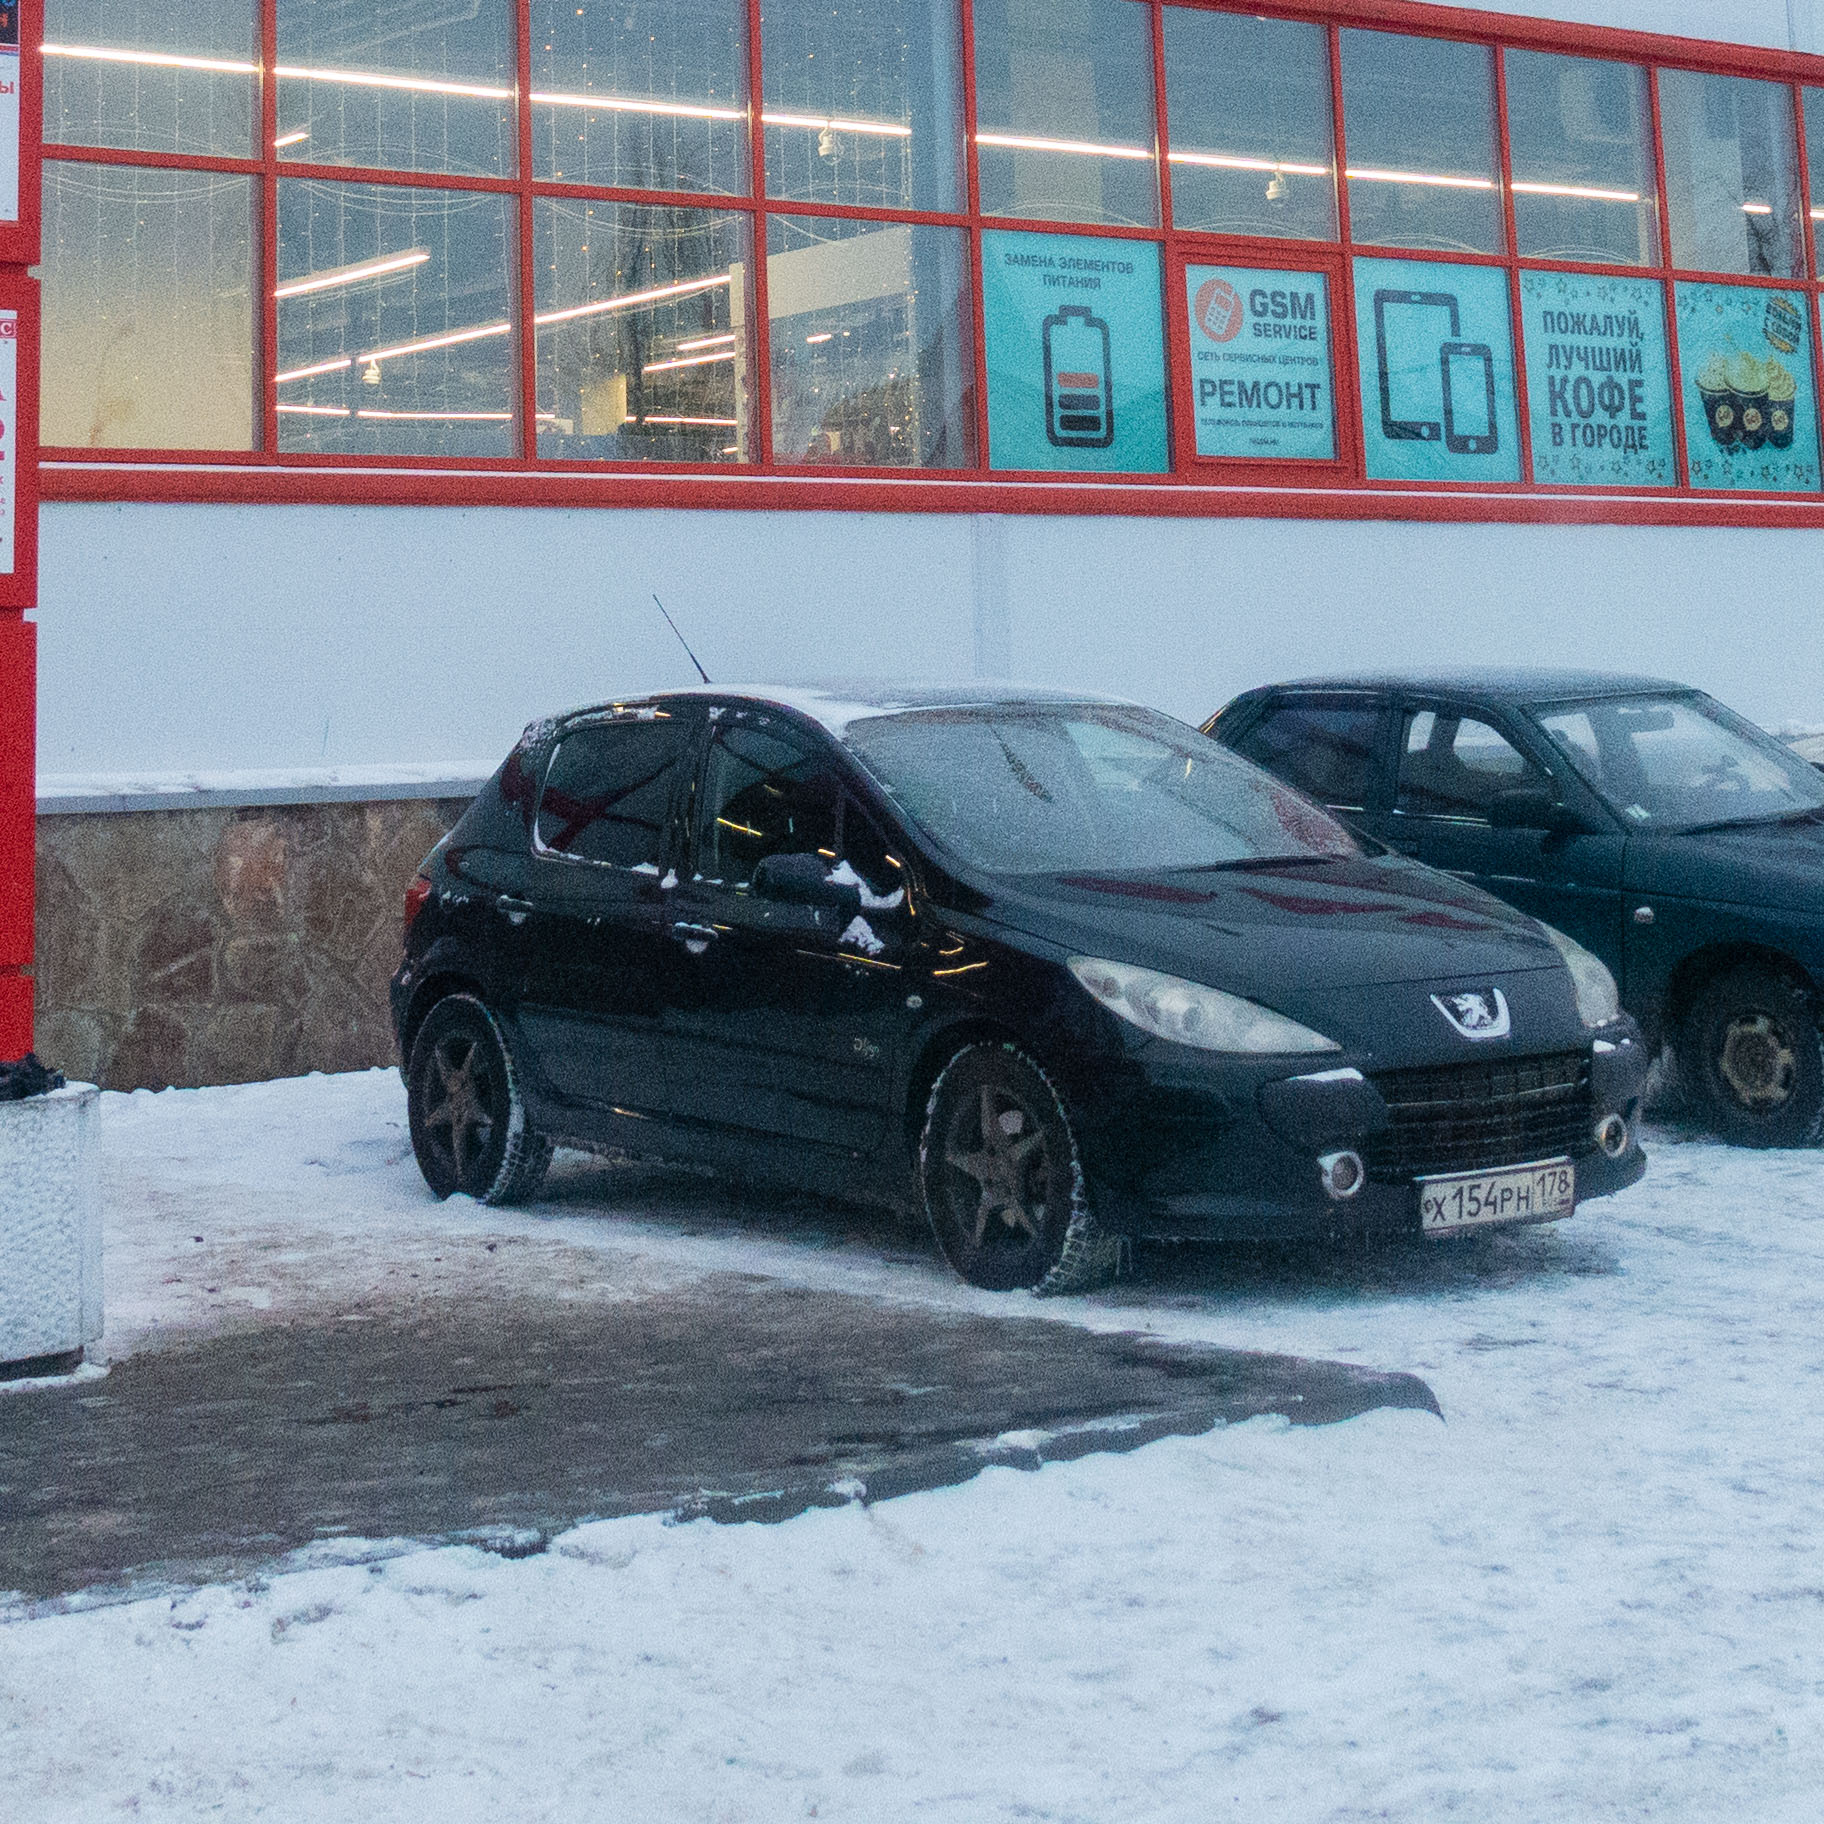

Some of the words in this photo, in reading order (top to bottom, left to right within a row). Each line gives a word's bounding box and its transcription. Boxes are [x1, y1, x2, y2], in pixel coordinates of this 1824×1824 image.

[1004, 253, 1055, 268] ЗАМЕНА
[1059, 257, 1134, 274] ЭЛЕМЕНТОВ
[1042, 274, 1101, 289] ПИТАНИЯ
[1249, 288, 1316, 321] GSM
[1252, 322, 1318, 341] SERVICE
[1542, 309, 1644, 341] ПОЖАЛУЙ,
[1547, 341, 1643, 373] ЛУЧШИЙ
[1199, 378, 1321, 411] РЕМОНТ
[1548, 375, 1647, 421] КОФЕ
[1551, 423, 1564, 447] В
[1571, 423, 1649, 454] ГОРОДЕ
